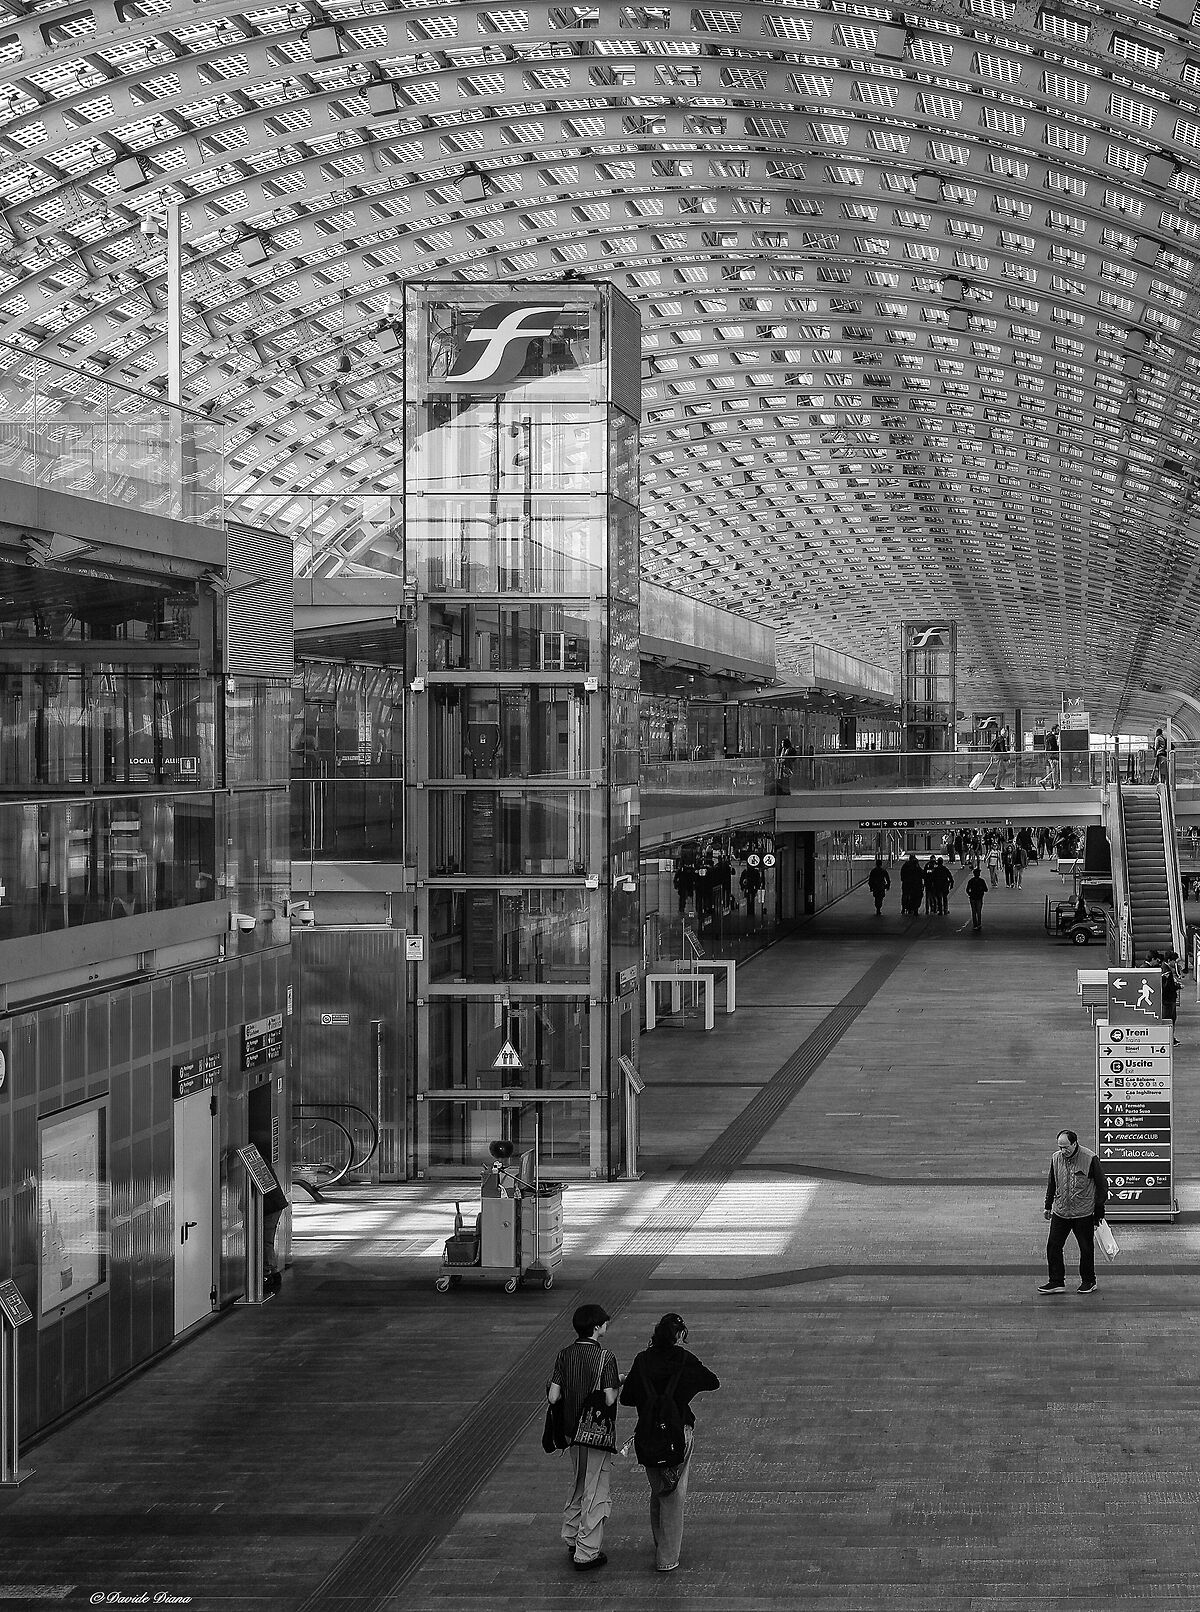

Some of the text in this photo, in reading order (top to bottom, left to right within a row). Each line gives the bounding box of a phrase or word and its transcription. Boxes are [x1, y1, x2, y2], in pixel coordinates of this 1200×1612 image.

[1125, 1028, 1149, 1036] Treni
[1150, 1046, 1166, 1054] 1-6
[1117, 1190, 1143, 1200] GTT
